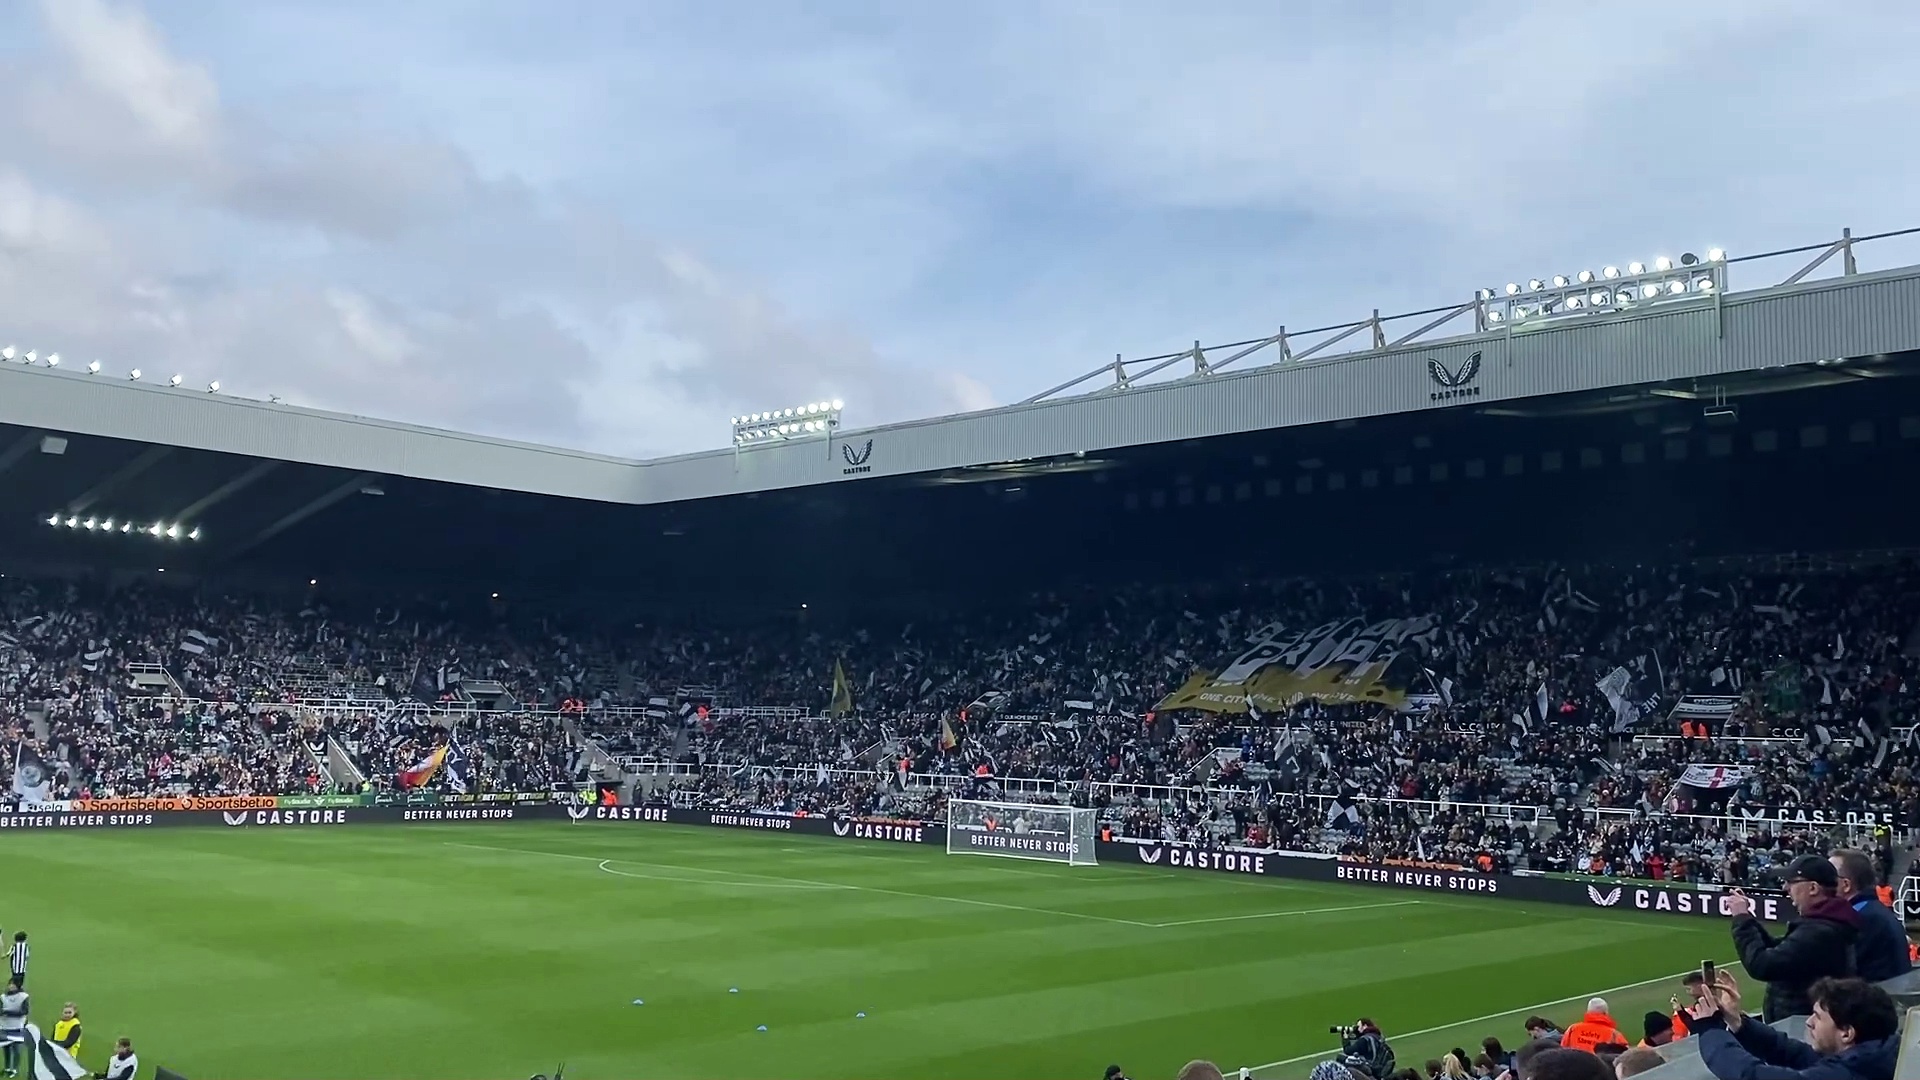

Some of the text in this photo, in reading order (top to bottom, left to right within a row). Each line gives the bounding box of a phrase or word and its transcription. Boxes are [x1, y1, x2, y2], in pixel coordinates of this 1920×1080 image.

[1431, 387, 1480, 401] CASTORE
[843, 466, 871, 474] CASTORE
[196, 797, 274, 809] Sportsbet.io
[1, 815, 153, 827] BETTER NEVER STOPS
[256, 810, 346, 825] CASTORE
[404, 809, 513, 820] BETTER NEVER STOPS
[596, 807, 668, 821] CASTORE
[711, 814, 791, 829] BETTER NEVER STOPS
[1778, 808, 1893, 824] CASORE
[855, 823, 923, 842] CASTORE
[971, 834, 1006, 847] BETTER
[1009, 839, 1041, 851] NEVER
[1170, 849, 1265, 873] CASTORE
[1337, 866, 1497, 892] BETTER NEVER STOPS
